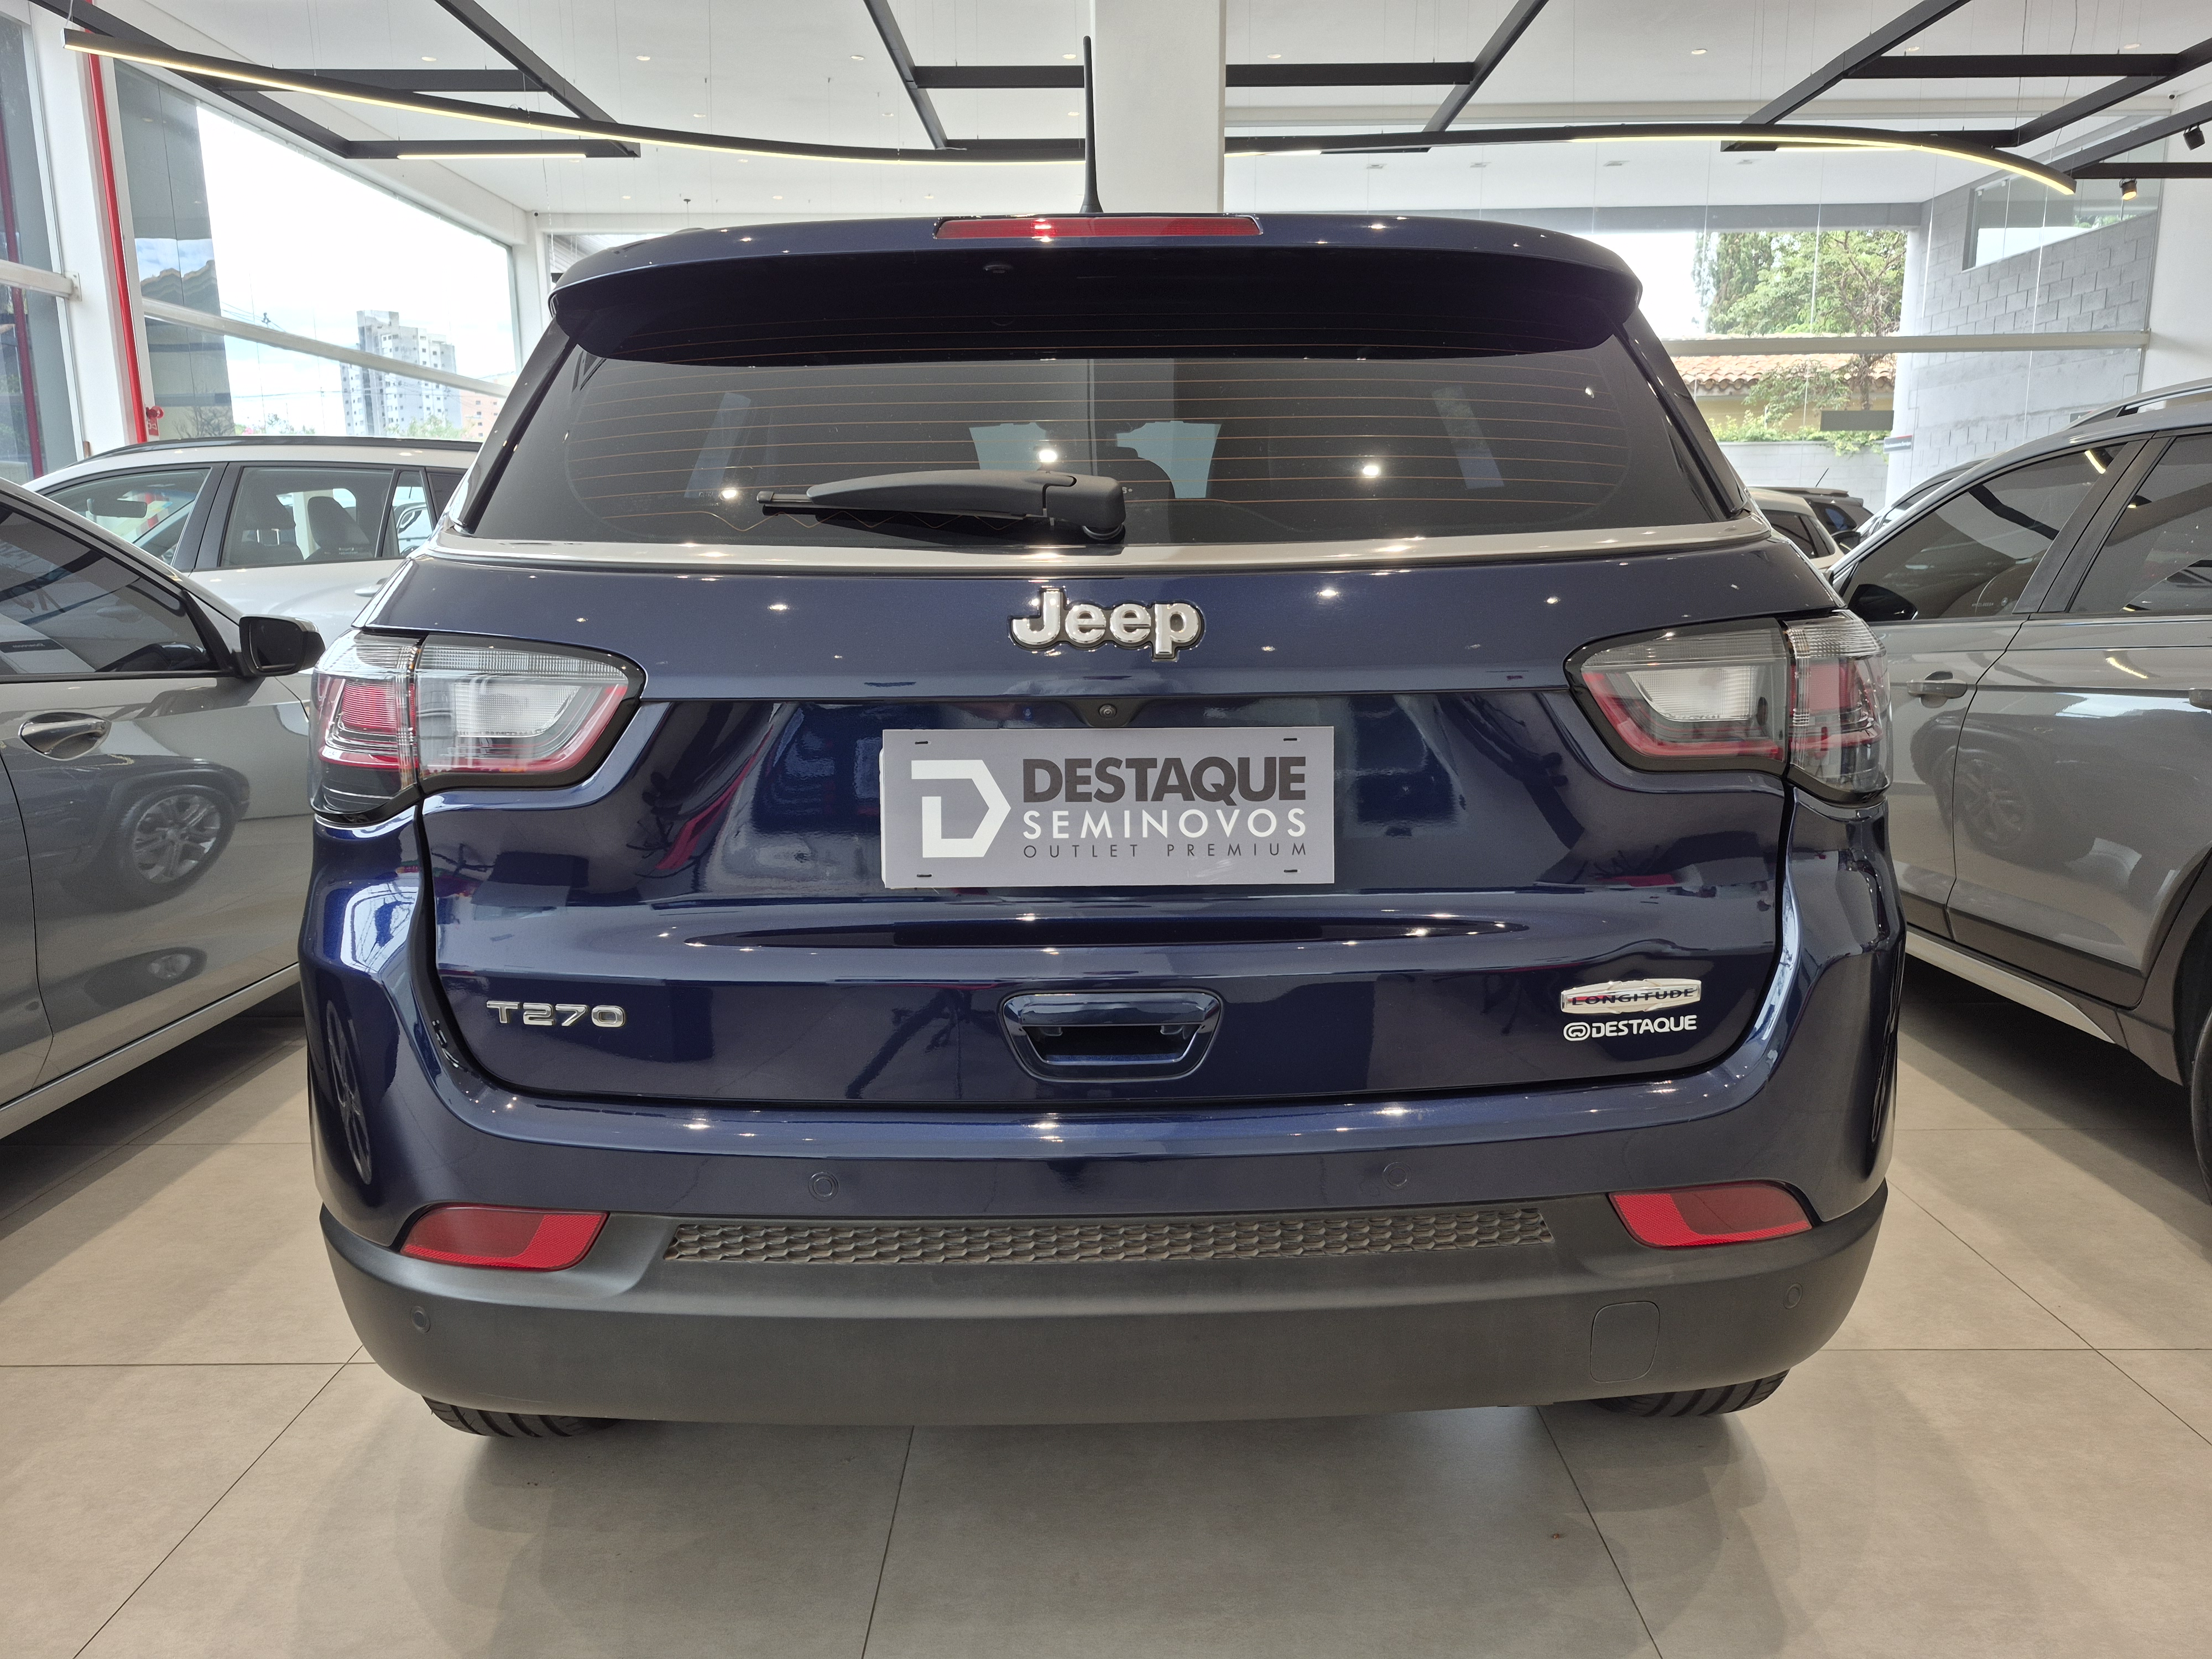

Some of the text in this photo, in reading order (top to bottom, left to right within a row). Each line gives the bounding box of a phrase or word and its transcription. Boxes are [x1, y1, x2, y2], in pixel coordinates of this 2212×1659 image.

[1010, 588, 1202, 658] Jeep
[1022, 756, 1306, 806] DESTAQUE
[1023, 808, 1306, 840] SEMINOVOS
[1023, 842, 1306, 858] OUTLET PREMIUM
[1572, 988, 1694, 1006] LONGITUDE
[486, 1000, 626, 1027] T270
